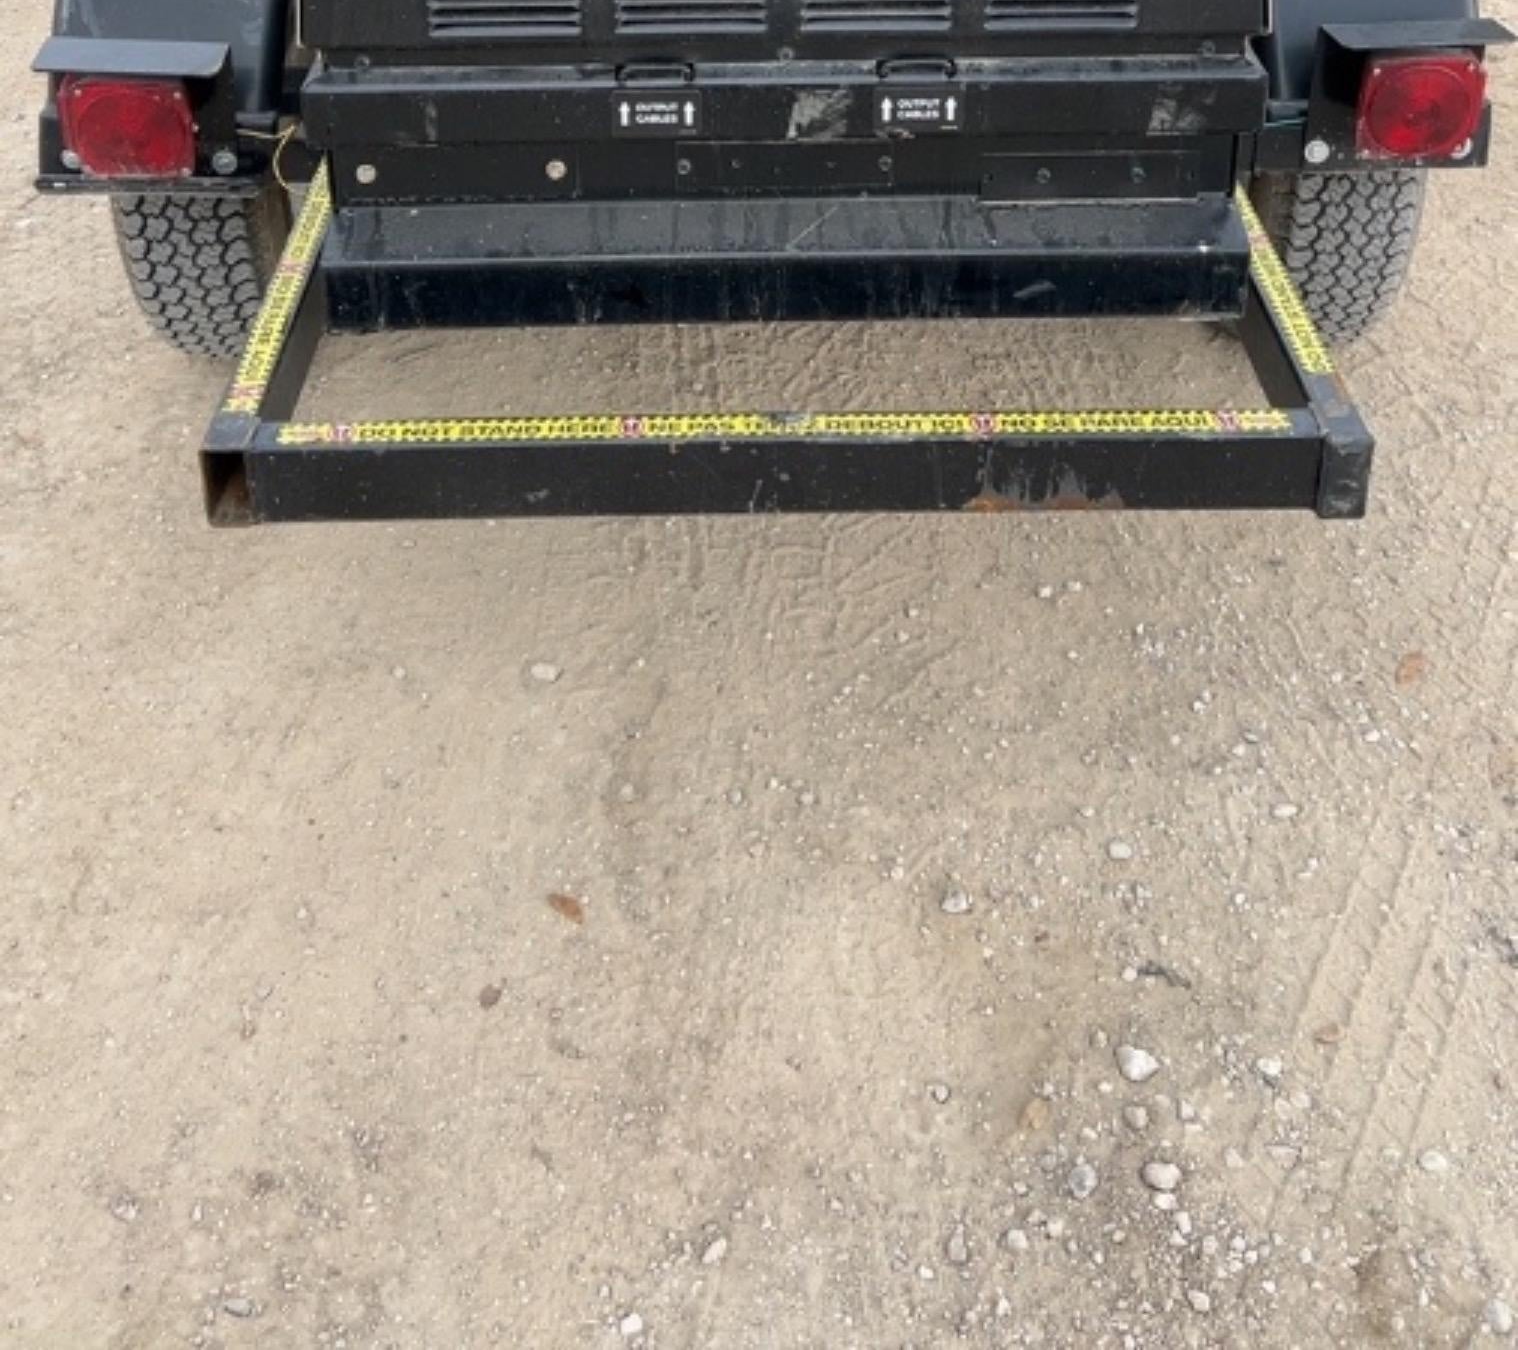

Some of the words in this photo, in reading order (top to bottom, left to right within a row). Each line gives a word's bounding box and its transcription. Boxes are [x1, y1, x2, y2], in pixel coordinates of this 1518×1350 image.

[635, 102, 679, 112] OUTPUT
[897, 98, 940, 109] OUTPUT
[635, 113, 679, 124] CABLES
[896, 110, 940, 120] CABLES
